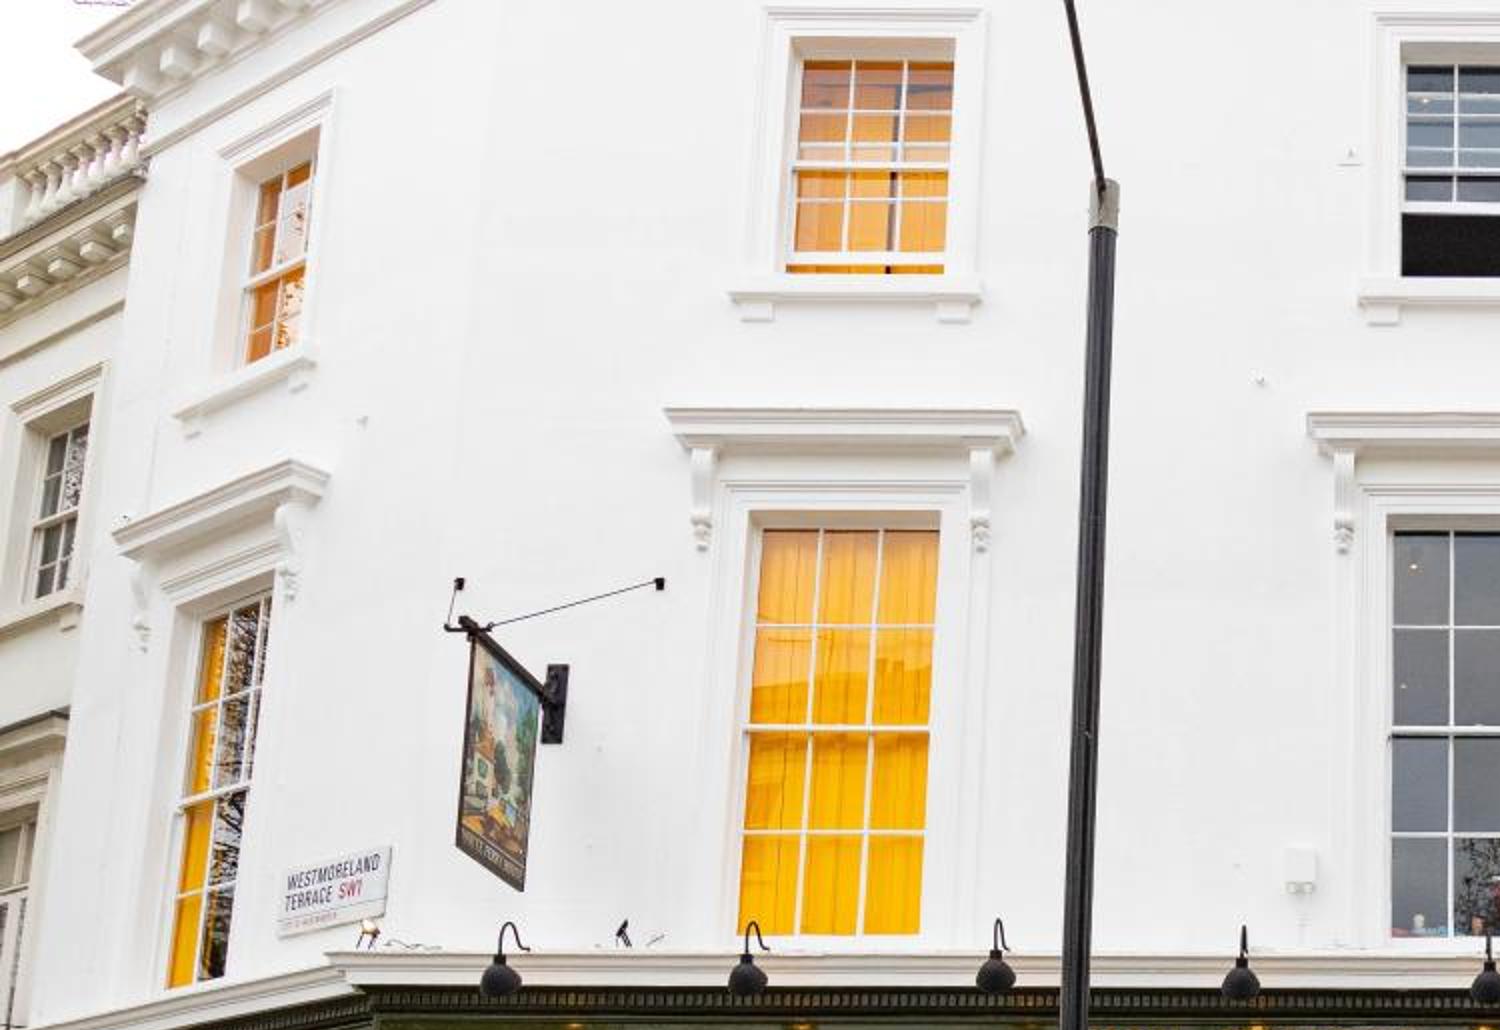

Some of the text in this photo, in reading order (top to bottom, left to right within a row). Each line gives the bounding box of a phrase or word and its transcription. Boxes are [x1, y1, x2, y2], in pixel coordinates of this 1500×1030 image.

[287, 853, 381, 890] WESTMORELAND
[285, 879, 363, 912] TERRACE SW1
